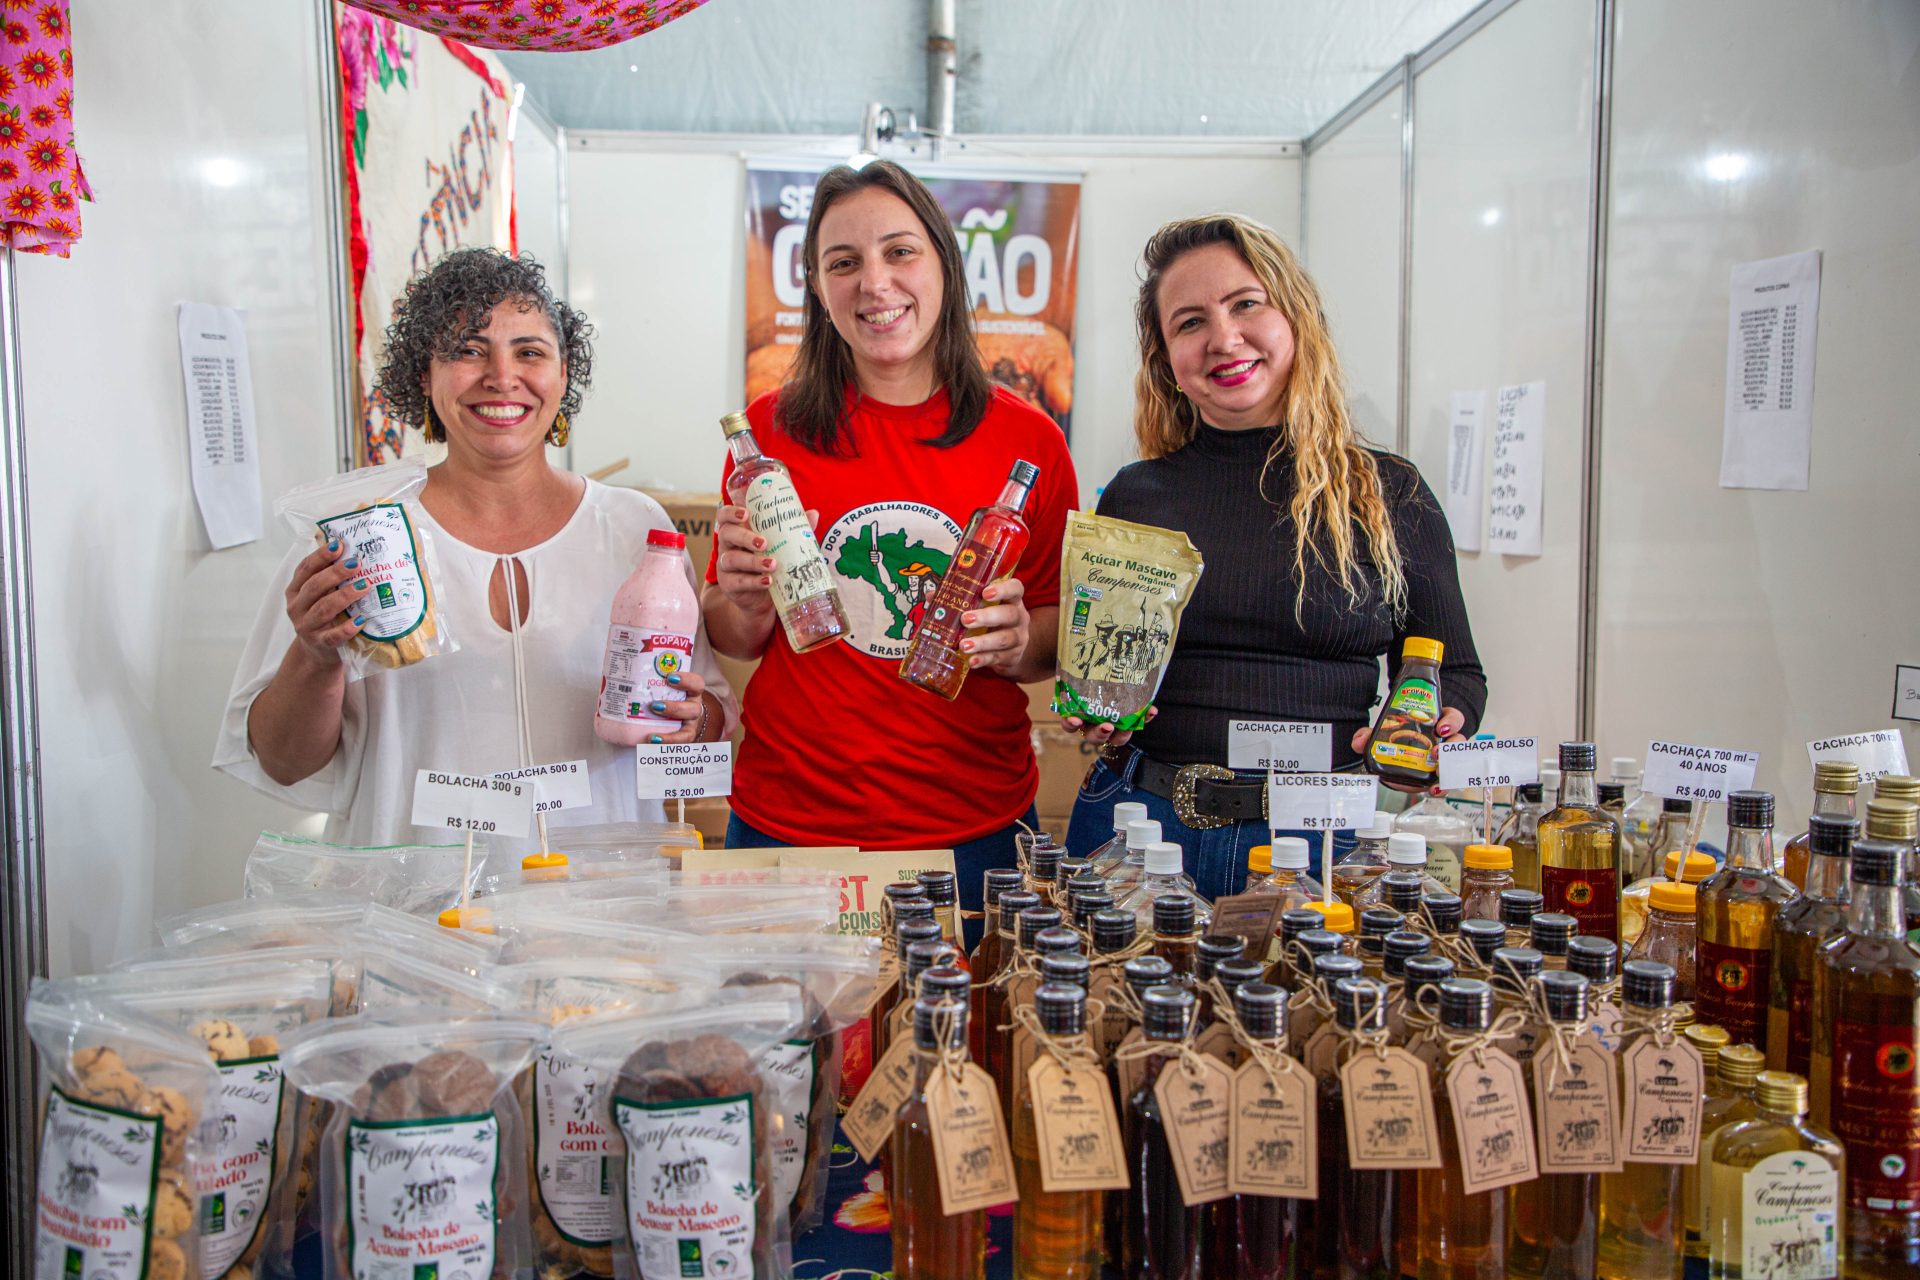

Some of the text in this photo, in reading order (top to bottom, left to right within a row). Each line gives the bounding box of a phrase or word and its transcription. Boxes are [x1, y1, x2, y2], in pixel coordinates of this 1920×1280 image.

[825, 528, 841, 551] DOS
[843, 503, 940, 526] TRABALHADORES
[1081, 552, 1177, 581] Açúcar Mascavo
[1087, 568, 1163, 596] Camponeses
[1138, 574, 1176, 589] Orgânico
[652, 635, 689, 648] COPAVI
[870, 644, 910, 656] BRASI
[1087, 703, 1120, 723] 500g
[1236, 723, 1286, 734] CACHAÇA
[1289, 725, 1309, 733] PET
[660, 745, 690, 754] LIVRO
[701, 744, 708, 753] A
[1442, 739, 1534, 752] CACHAÇA BOLSO
[1813, 735, 1869, 751] CACHAÇA
[1651, 742, 1711, 759] CACHAÇA
[1714, 751, 1731, 761] 700
[1734, 754, 1747, 762] ml
[640, 754, 729, 765] CONSTRUÇÃO DO
[1258, 759, 1299, 769] R$ 30,00
[550, 764, 568, 774] 500
[570, 765, 577, 773] g
[665, 767, 704, 776] COMUM
[1680, 760, 1727, 774] 40 ANOS
[428, 773, 522, 796] BOLACHA 300 g
[1275, 777, 1372, 787] LICORES Sabores
[1468, 775, 1510, 786] R$ 17,00
[665, 788, 705, 797] R$ 20,00
[1676, 785, 1721, 799] R$ 40,00
[536, 800, 562, 812] 20,00
[447, 817, 496, 832] R$ 12,00
[1303, 818, 1346, 828] R$ 17,00
[1639, 1083, 1693, 1101] Camponeses
[560, 1139, 597, 1151] com
[223, 1151, 260, 1171] com
[647, 1200, 718, 1216] Bolacha de
[1755, 1188, 1833, 1214] Camponeses
[678, 1214, 740, 1232] Mascavo
[382, 1221, 460, 1241] Bolacha de
[417, 1234, 480, 1256] Mascavo
